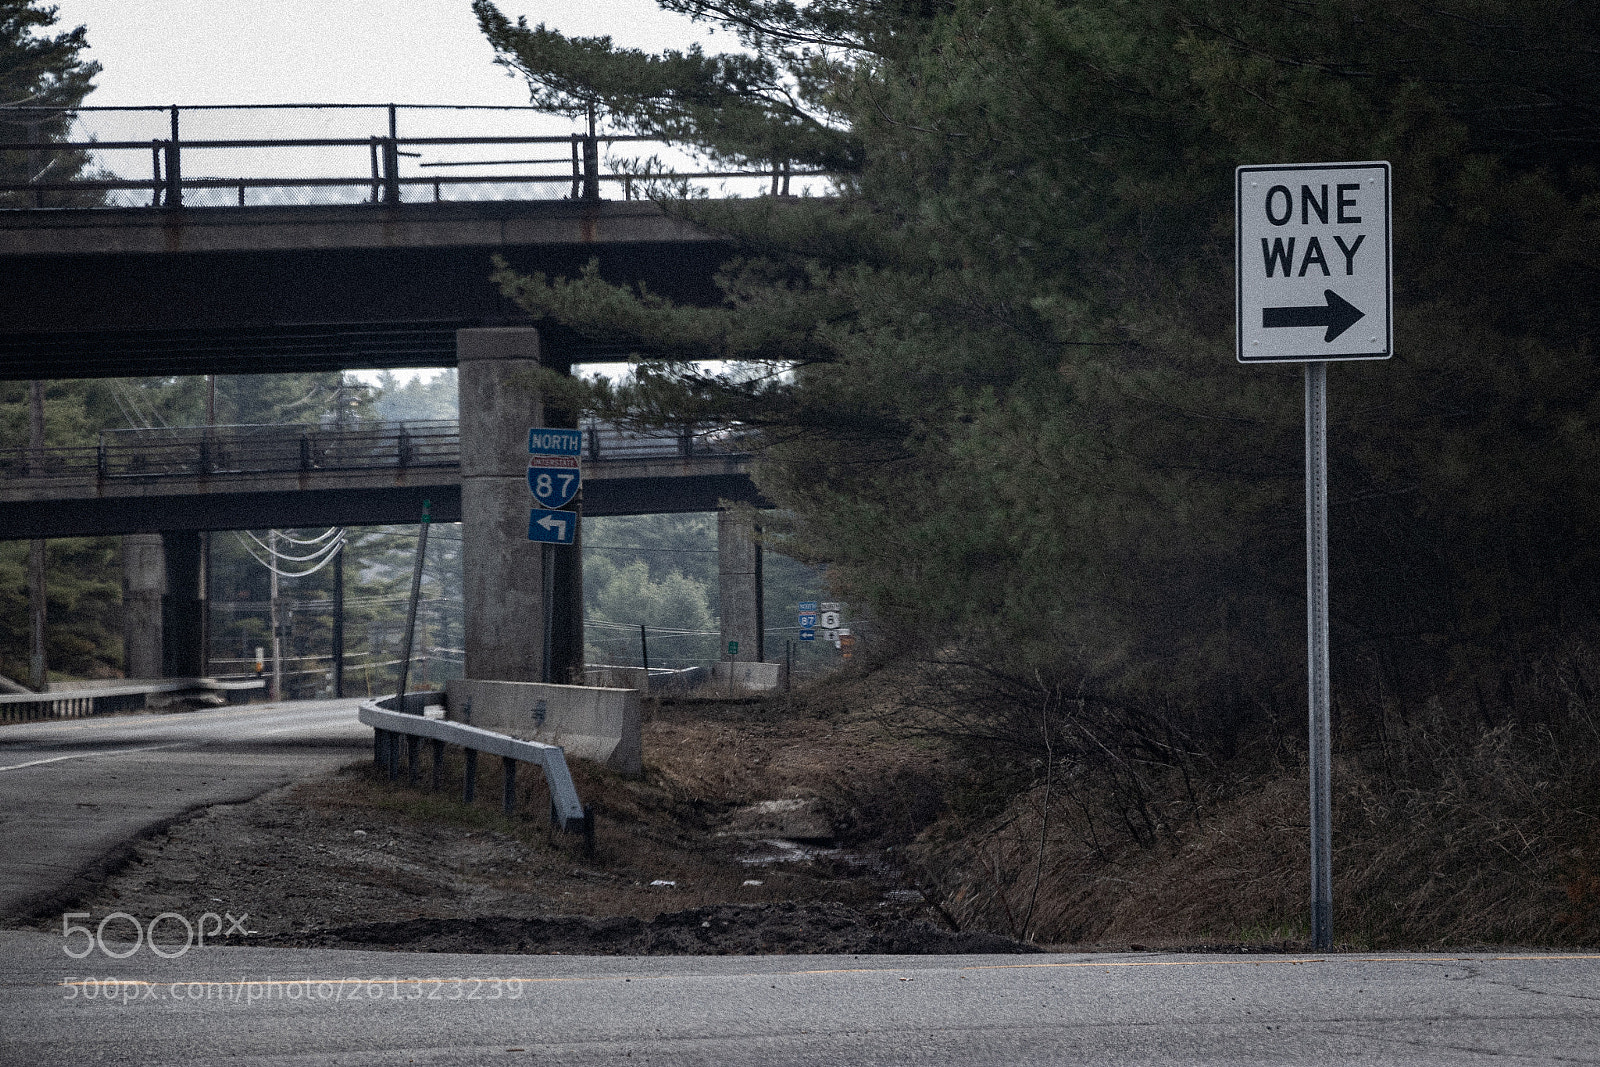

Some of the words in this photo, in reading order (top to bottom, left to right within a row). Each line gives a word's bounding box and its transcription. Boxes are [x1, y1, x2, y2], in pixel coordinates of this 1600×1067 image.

[1265, 183, 1362, 226] ONE
[1261, 234, 1366, 278] WAY
[532, 433, 578, 451] NORTH
[536, 474, 574, 498] 87
[801, 616, 814, 625] 87
